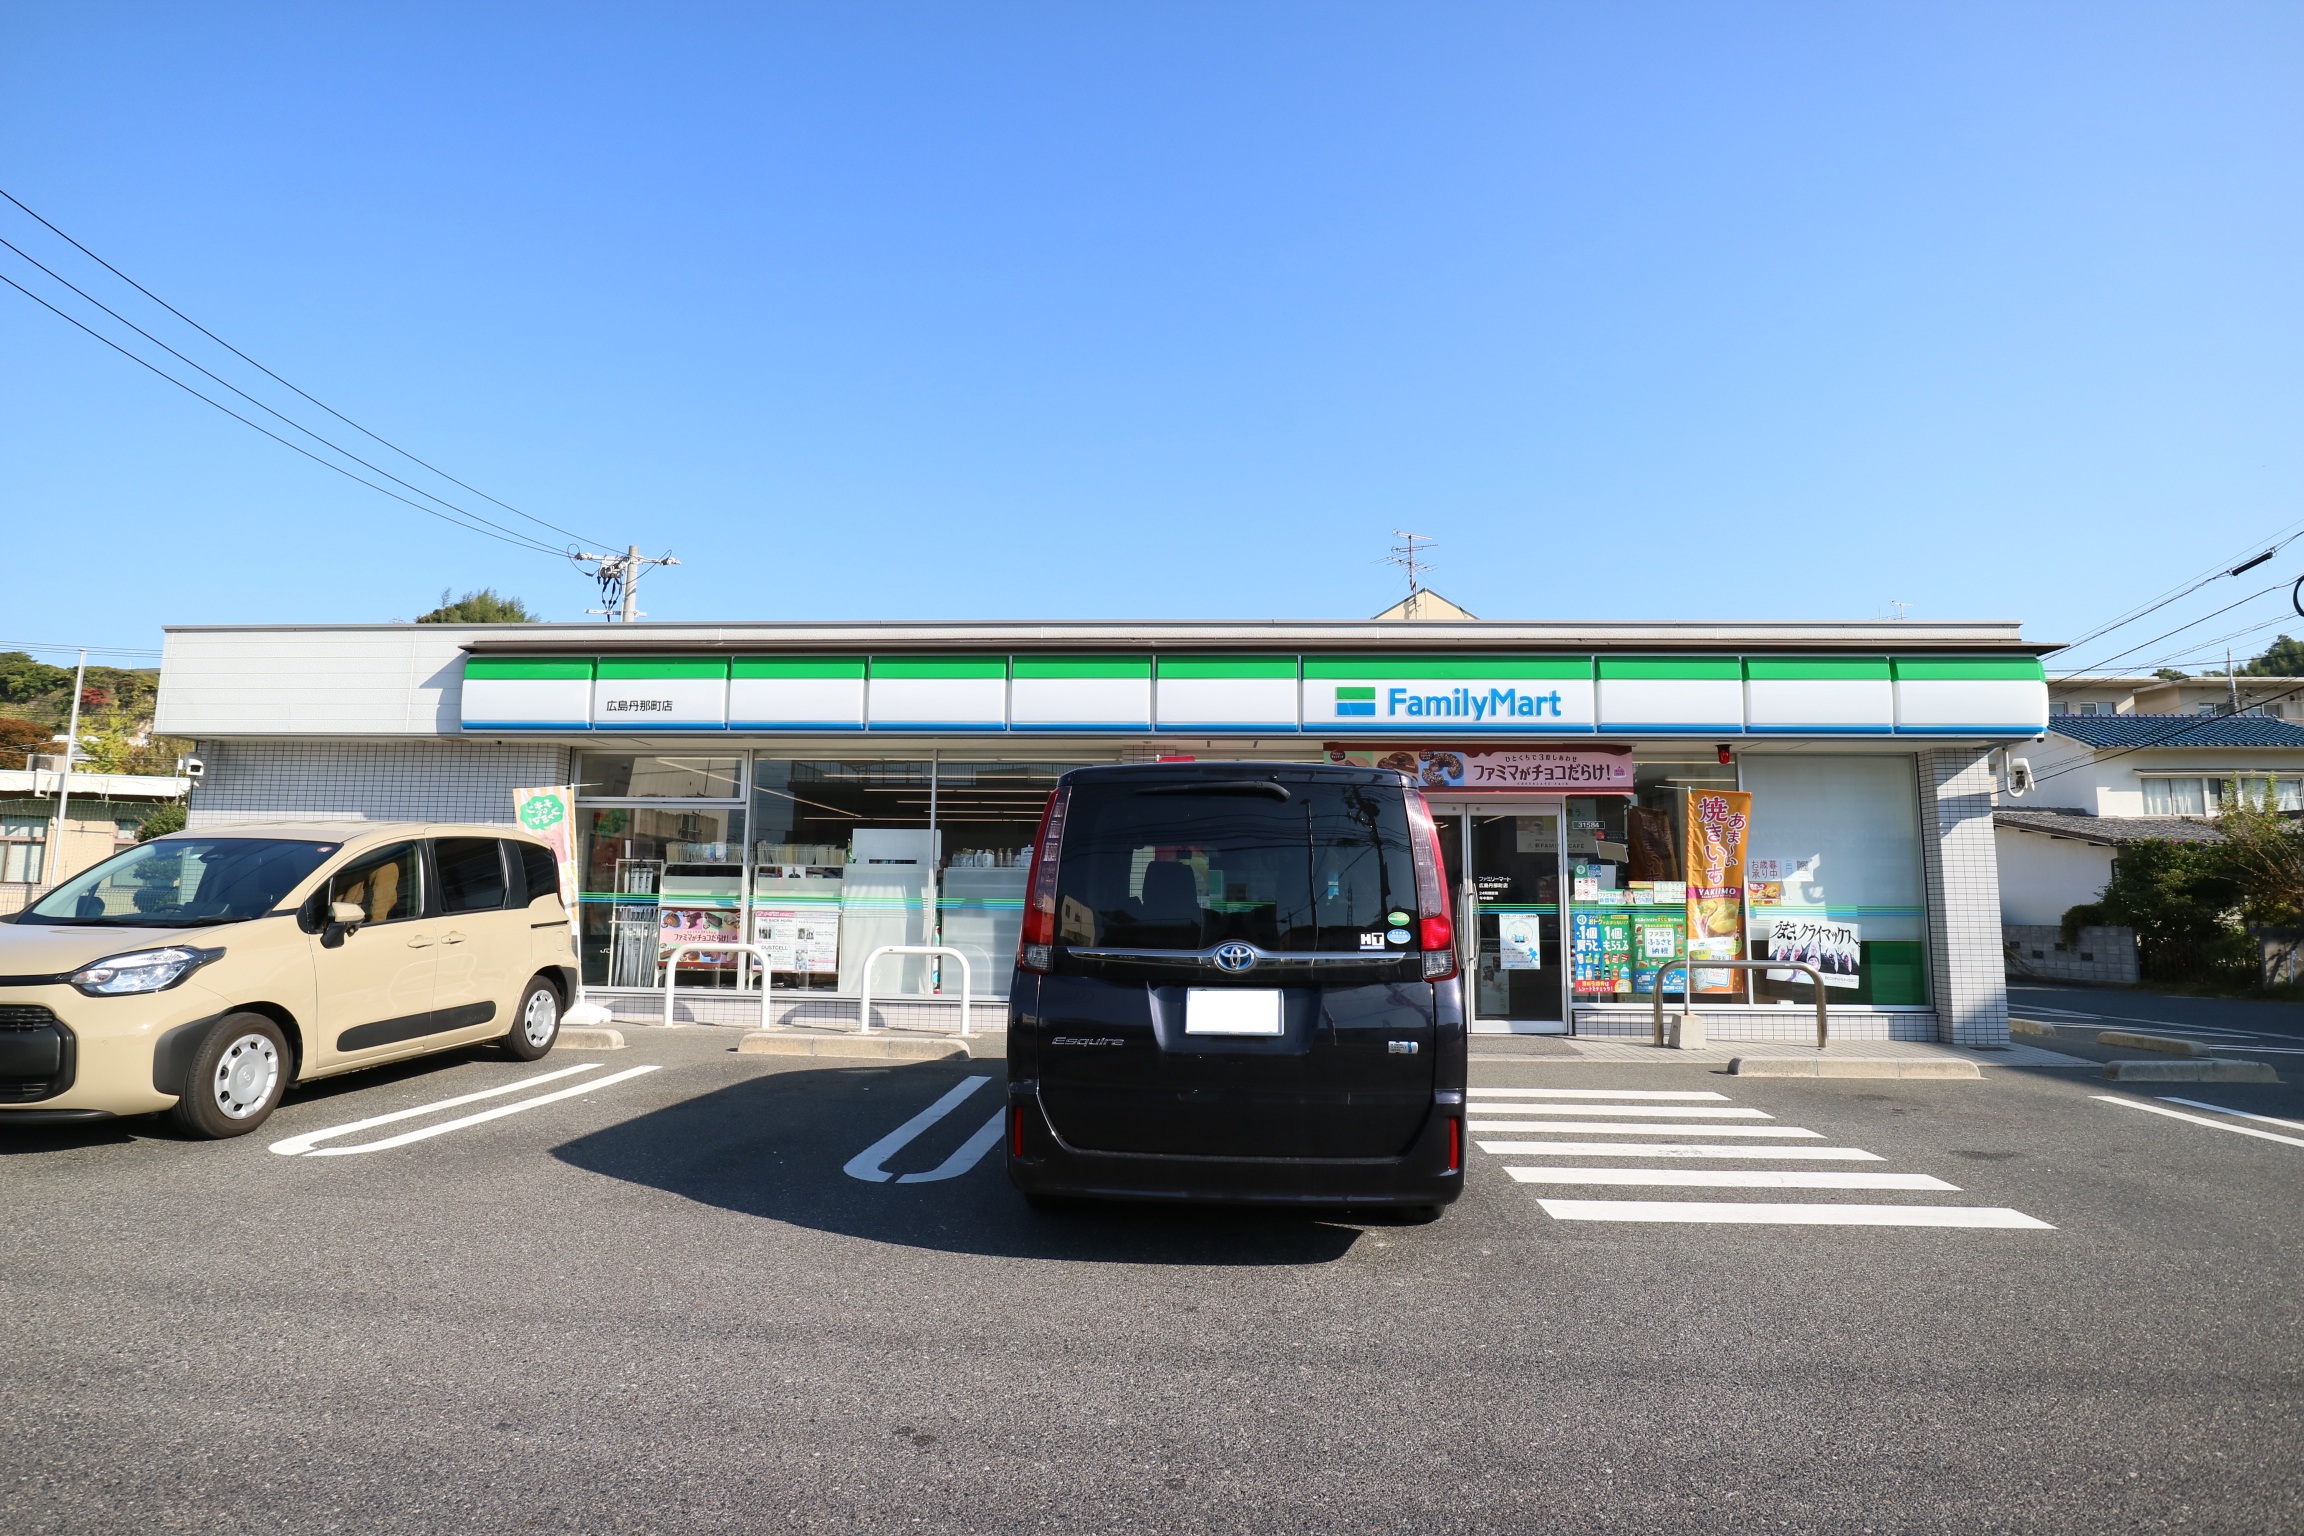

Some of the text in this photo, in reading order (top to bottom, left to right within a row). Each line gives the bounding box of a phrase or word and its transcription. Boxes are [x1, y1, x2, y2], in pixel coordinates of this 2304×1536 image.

[606, 699, 673, 712] 広島丹那町店
[1387, 687, 1562, 722] FamilyMart
[1698, 796, 1729, 886] 焼きいも
[1752, 859, 1777, 869] お歳暮
[1752, 869, 1777, 879] 承り中
[1698, 887, 1736, 896] YAKIIMO
[1602, 940, 1629, 951] もらえる
[1051, 1036, 1125, 1047] Esquire
